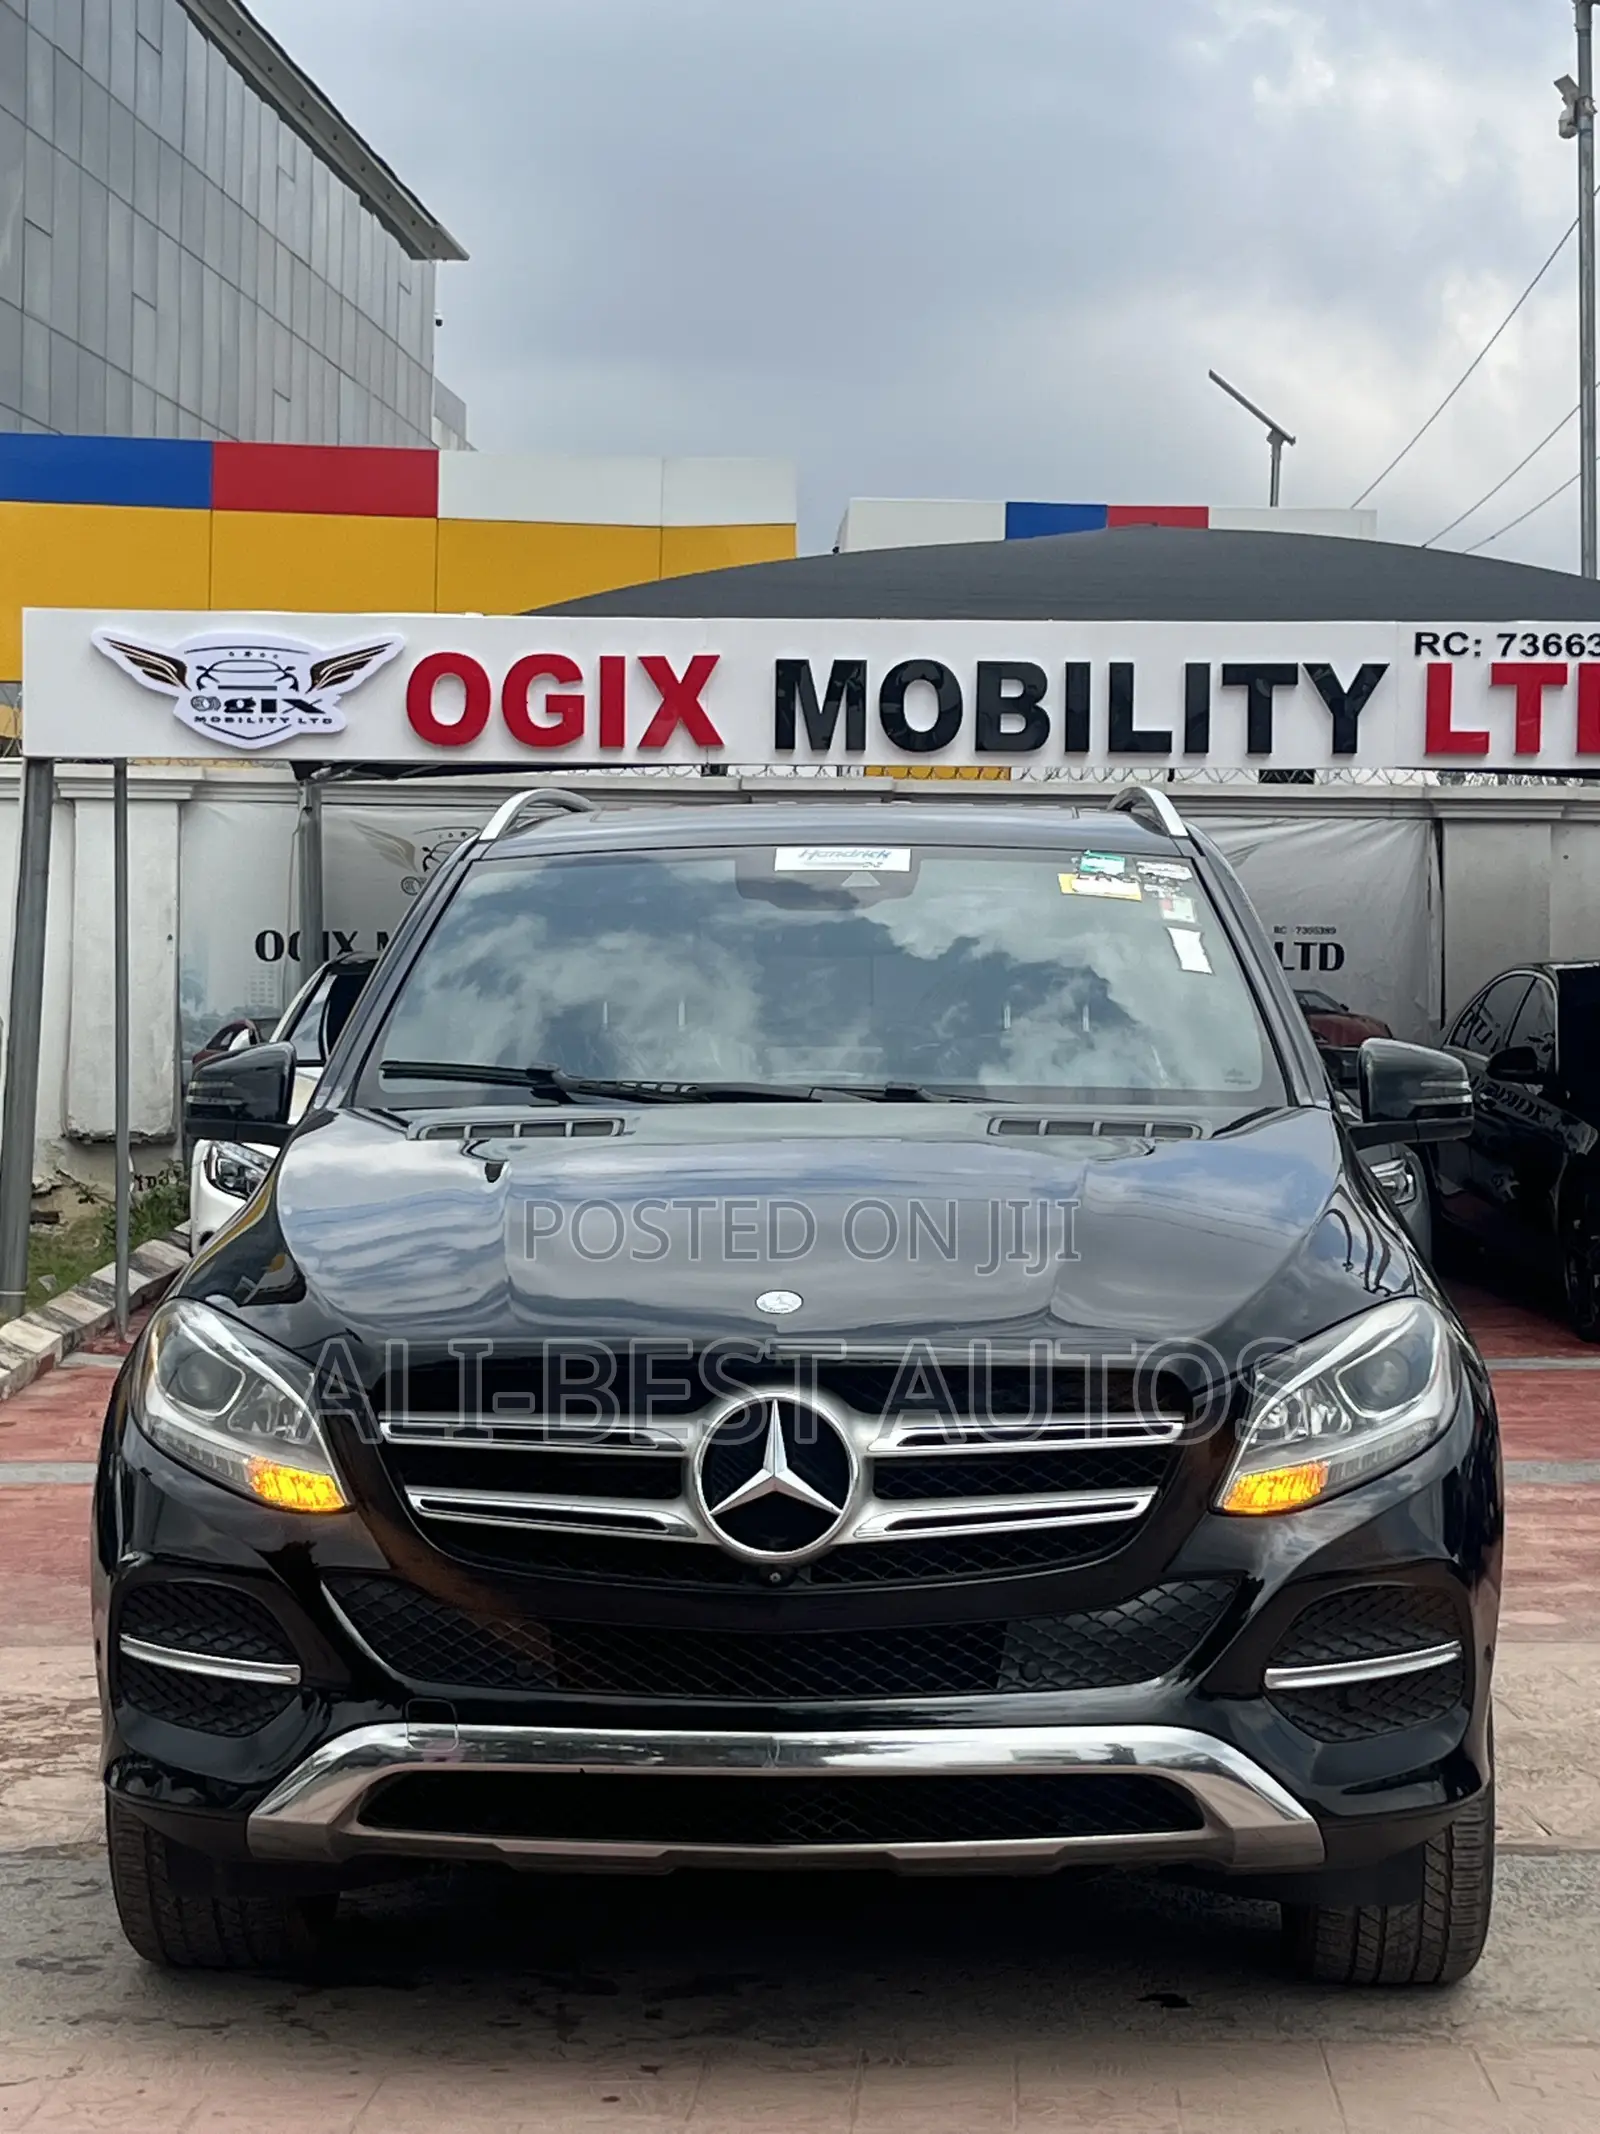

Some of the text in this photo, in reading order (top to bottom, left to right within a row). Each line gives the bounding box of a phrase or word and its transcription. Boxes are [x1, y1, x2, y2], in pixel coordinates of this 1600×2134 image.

[1414, 631, 1482, 657] RC:
[405, 651, 724, 750] OGIX
[774, 658, 1390, 754] MOBILITY
[194, 715, 333, 725] MOBILITY LTD
